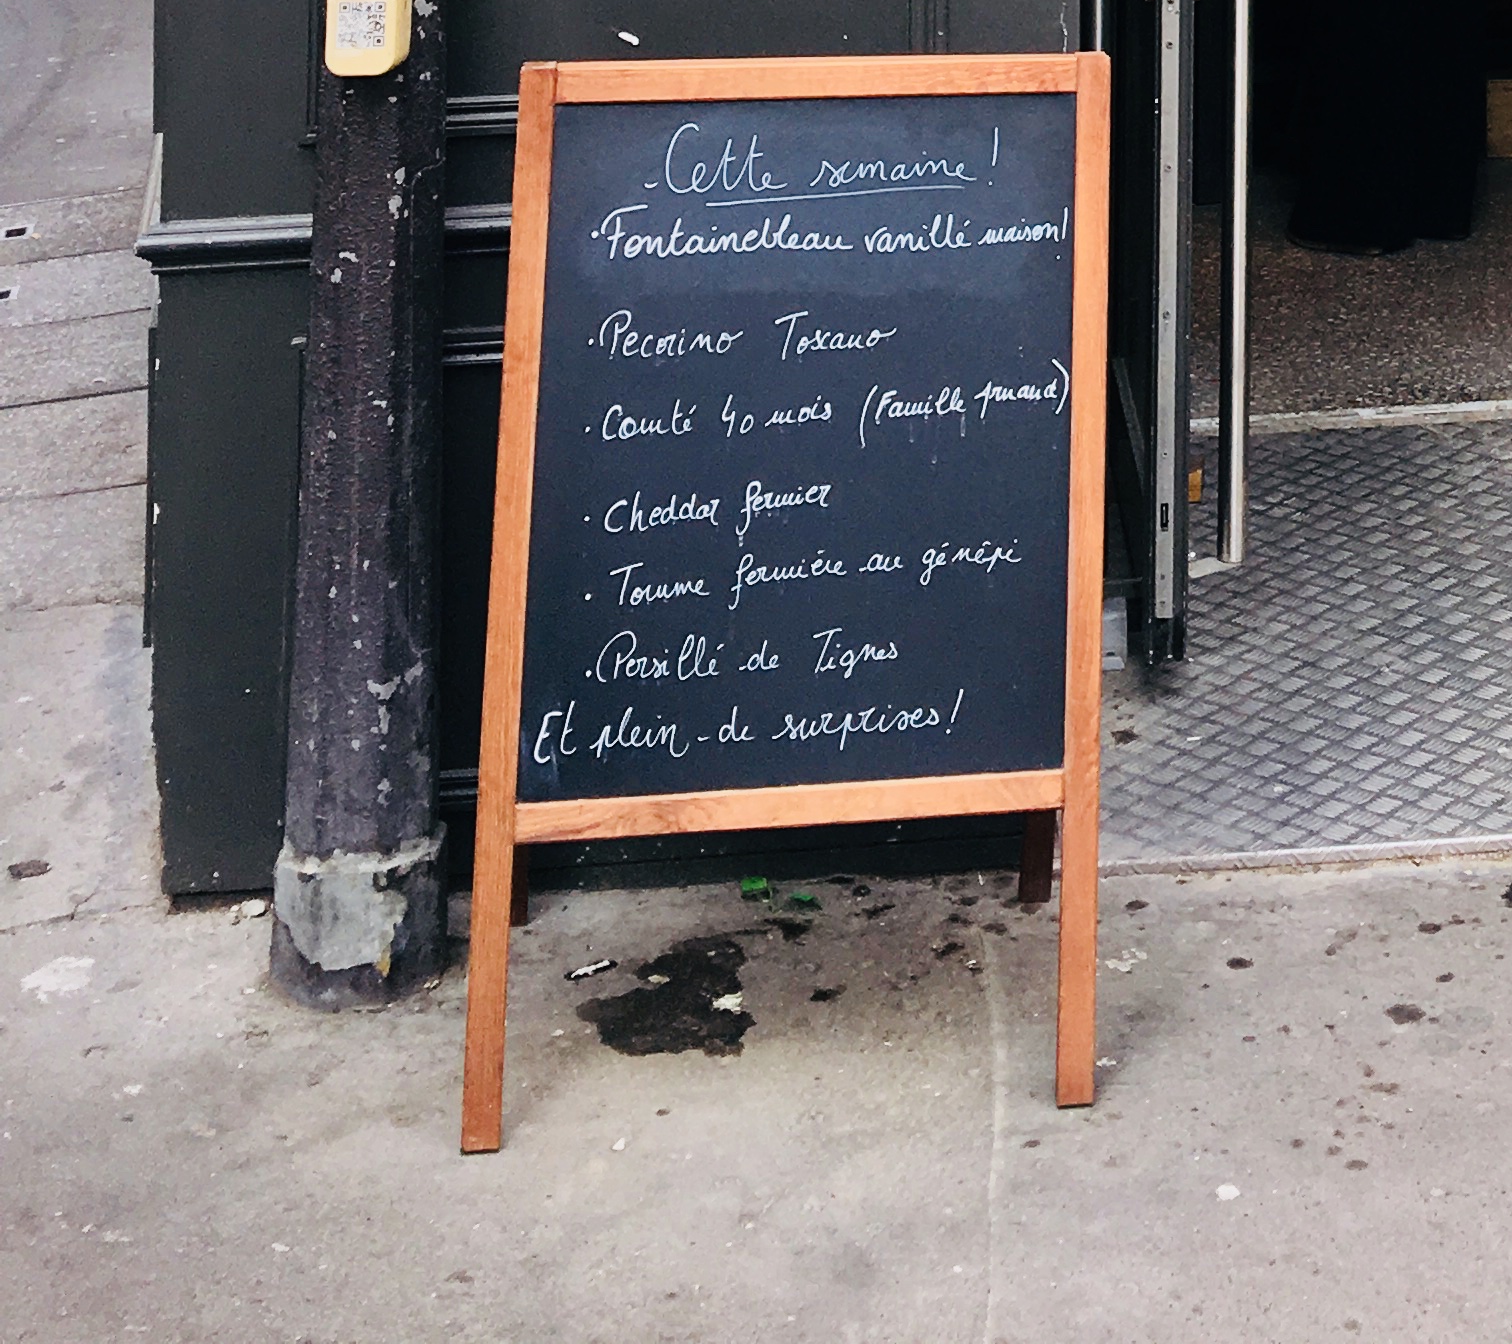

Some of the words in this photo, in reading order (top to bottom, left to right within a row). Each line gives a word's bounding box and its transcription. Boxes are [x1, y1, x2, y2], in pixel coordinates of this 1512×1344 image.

[775, 310, 897, 361] Toscano
[722, 394, 755, 438] 40
[765, 396, 832, 429] mois
[604, 490, 719, 534] Cheddar
[735, 479, 832, 535] fermier
[610, 561, 710, 606] Tomme
[812, 626, 899, 680] Tignes
[534, 700, 577, 764] Et
